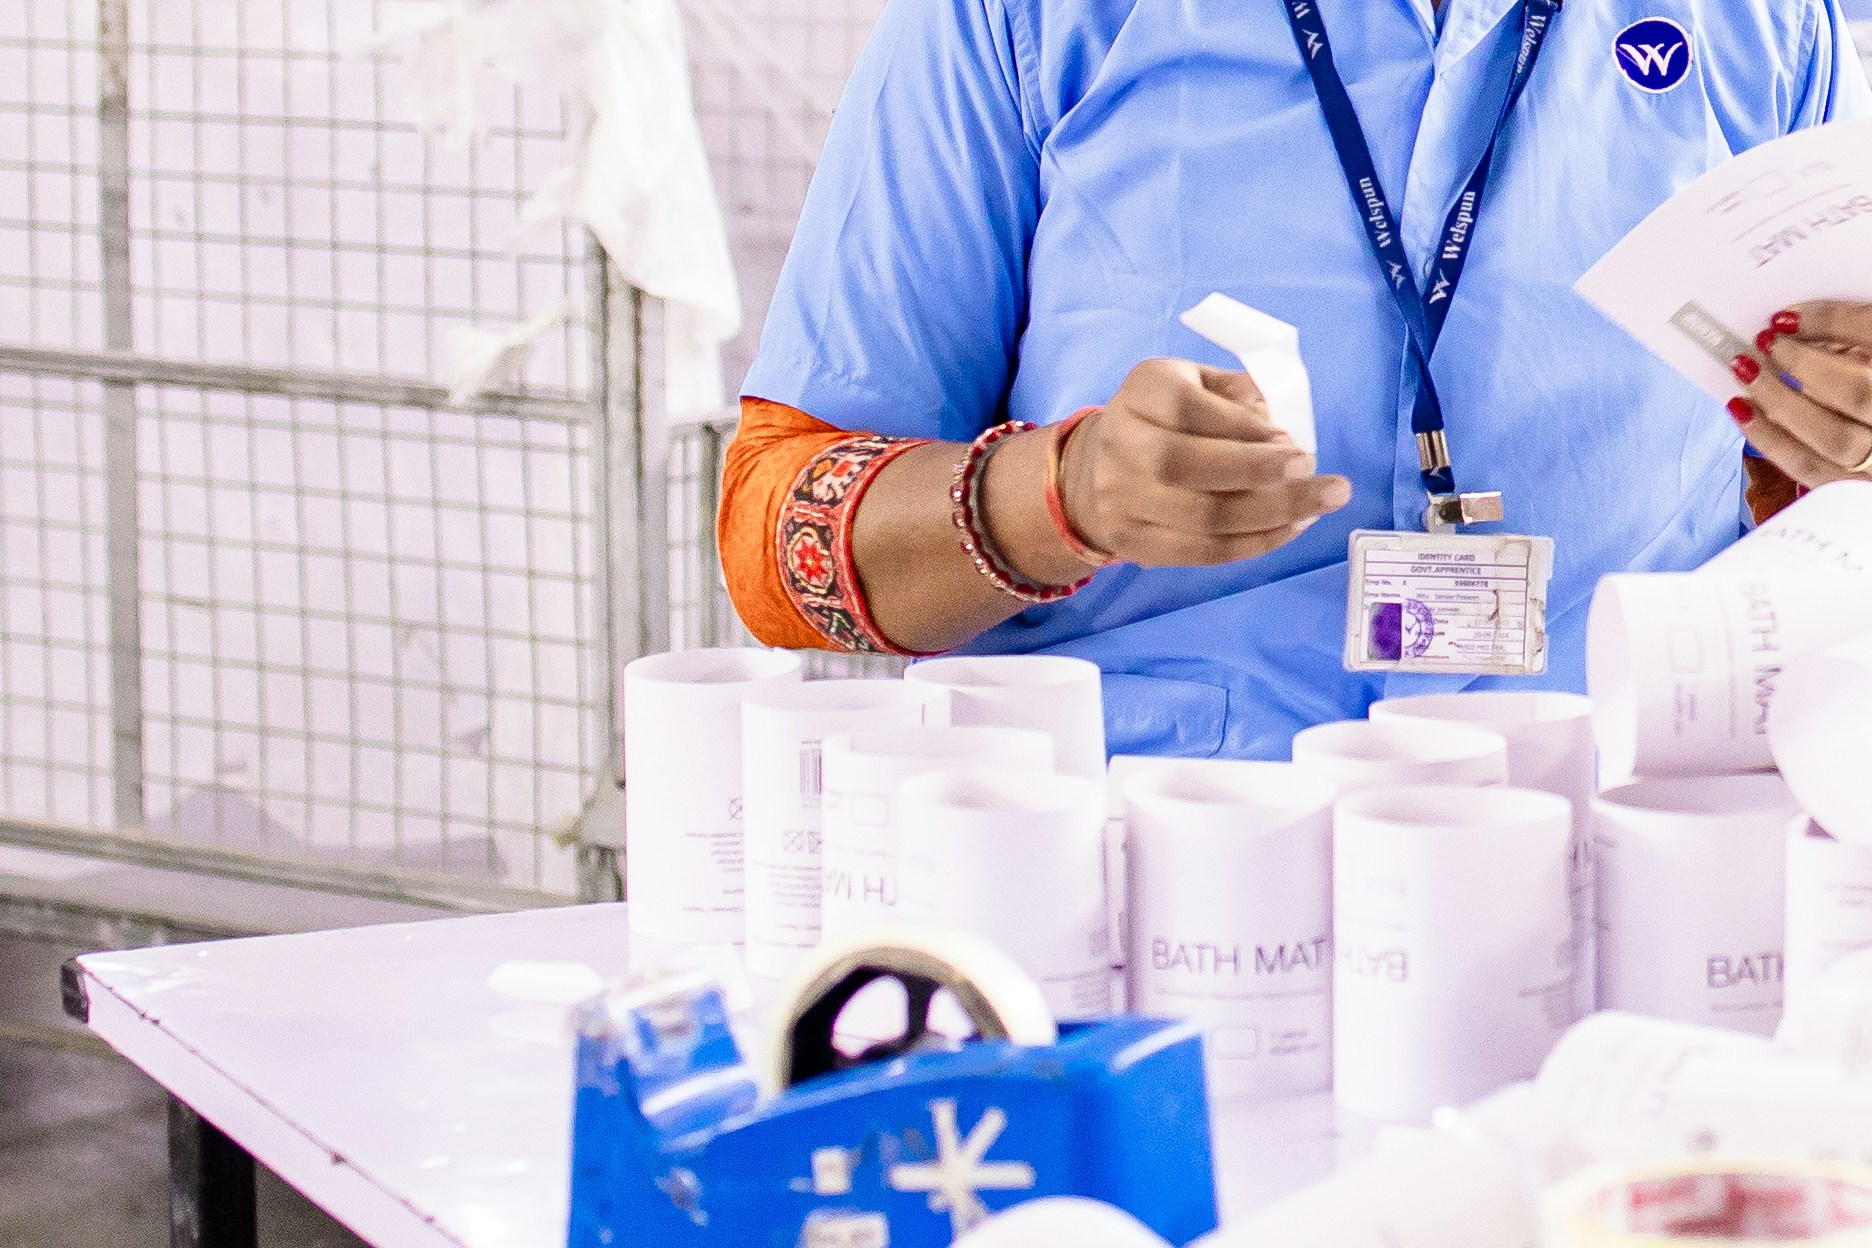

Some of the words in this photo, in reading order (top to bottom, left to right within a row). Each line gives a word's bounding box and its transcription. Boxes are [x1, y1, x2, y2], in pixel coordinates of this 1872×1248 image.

[1359, 176, 1392, 248] Welspun
[1441, 190, 1476, 259] Welspun
[1417, 553, 1453, 561] IDENTITY
[1454, 554, 1476, 562] CARD
[1150, 936, 1241, 975] BATH
[1254, 933, 1329, 976] MAT
